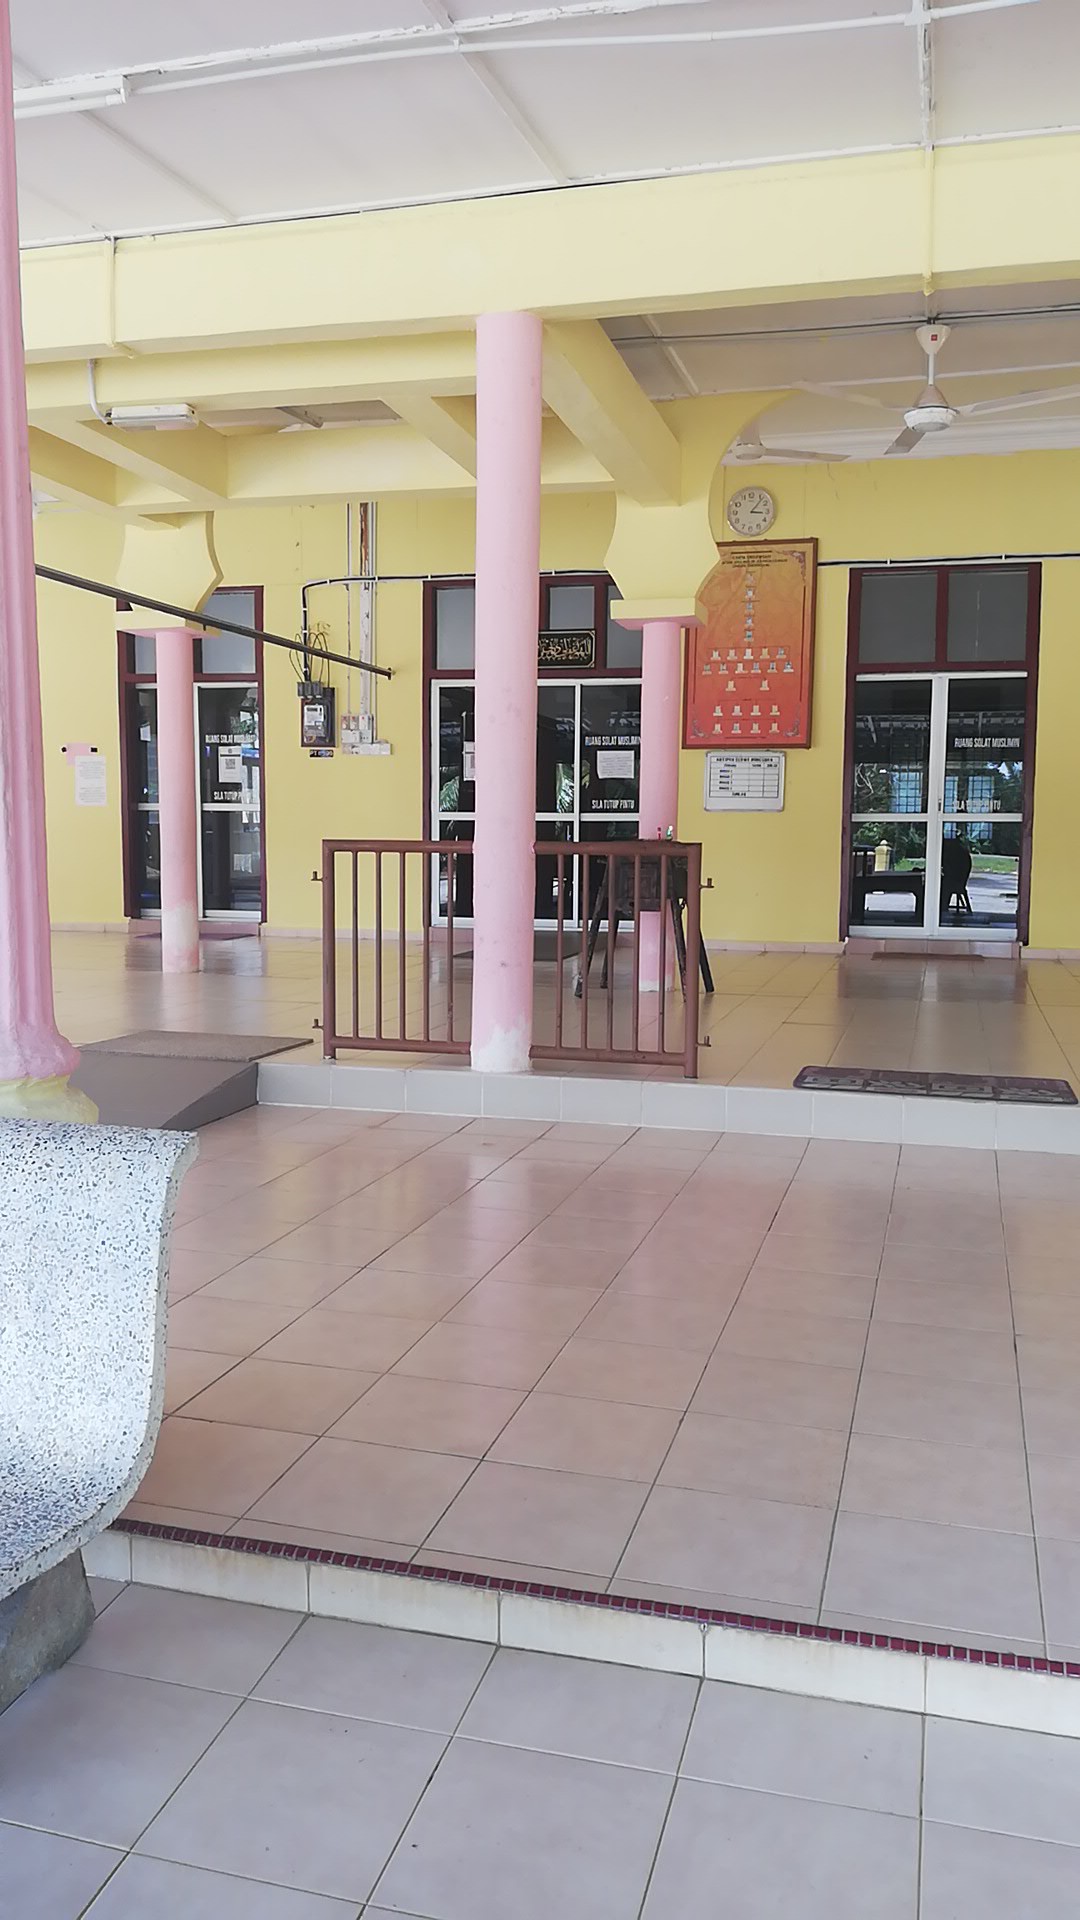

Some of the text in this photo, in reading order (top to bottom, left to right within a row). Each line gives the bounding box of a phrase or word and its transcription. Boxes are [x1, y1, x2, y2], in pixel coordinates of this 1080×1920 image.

[602, 736, 617, 746] SOLAT
[954, 738, 1020, 748] RUANG SOLAT MUSLIMIN
[214, 791, 224, 800] SILA
[592, 800, 603, 810] SILA
